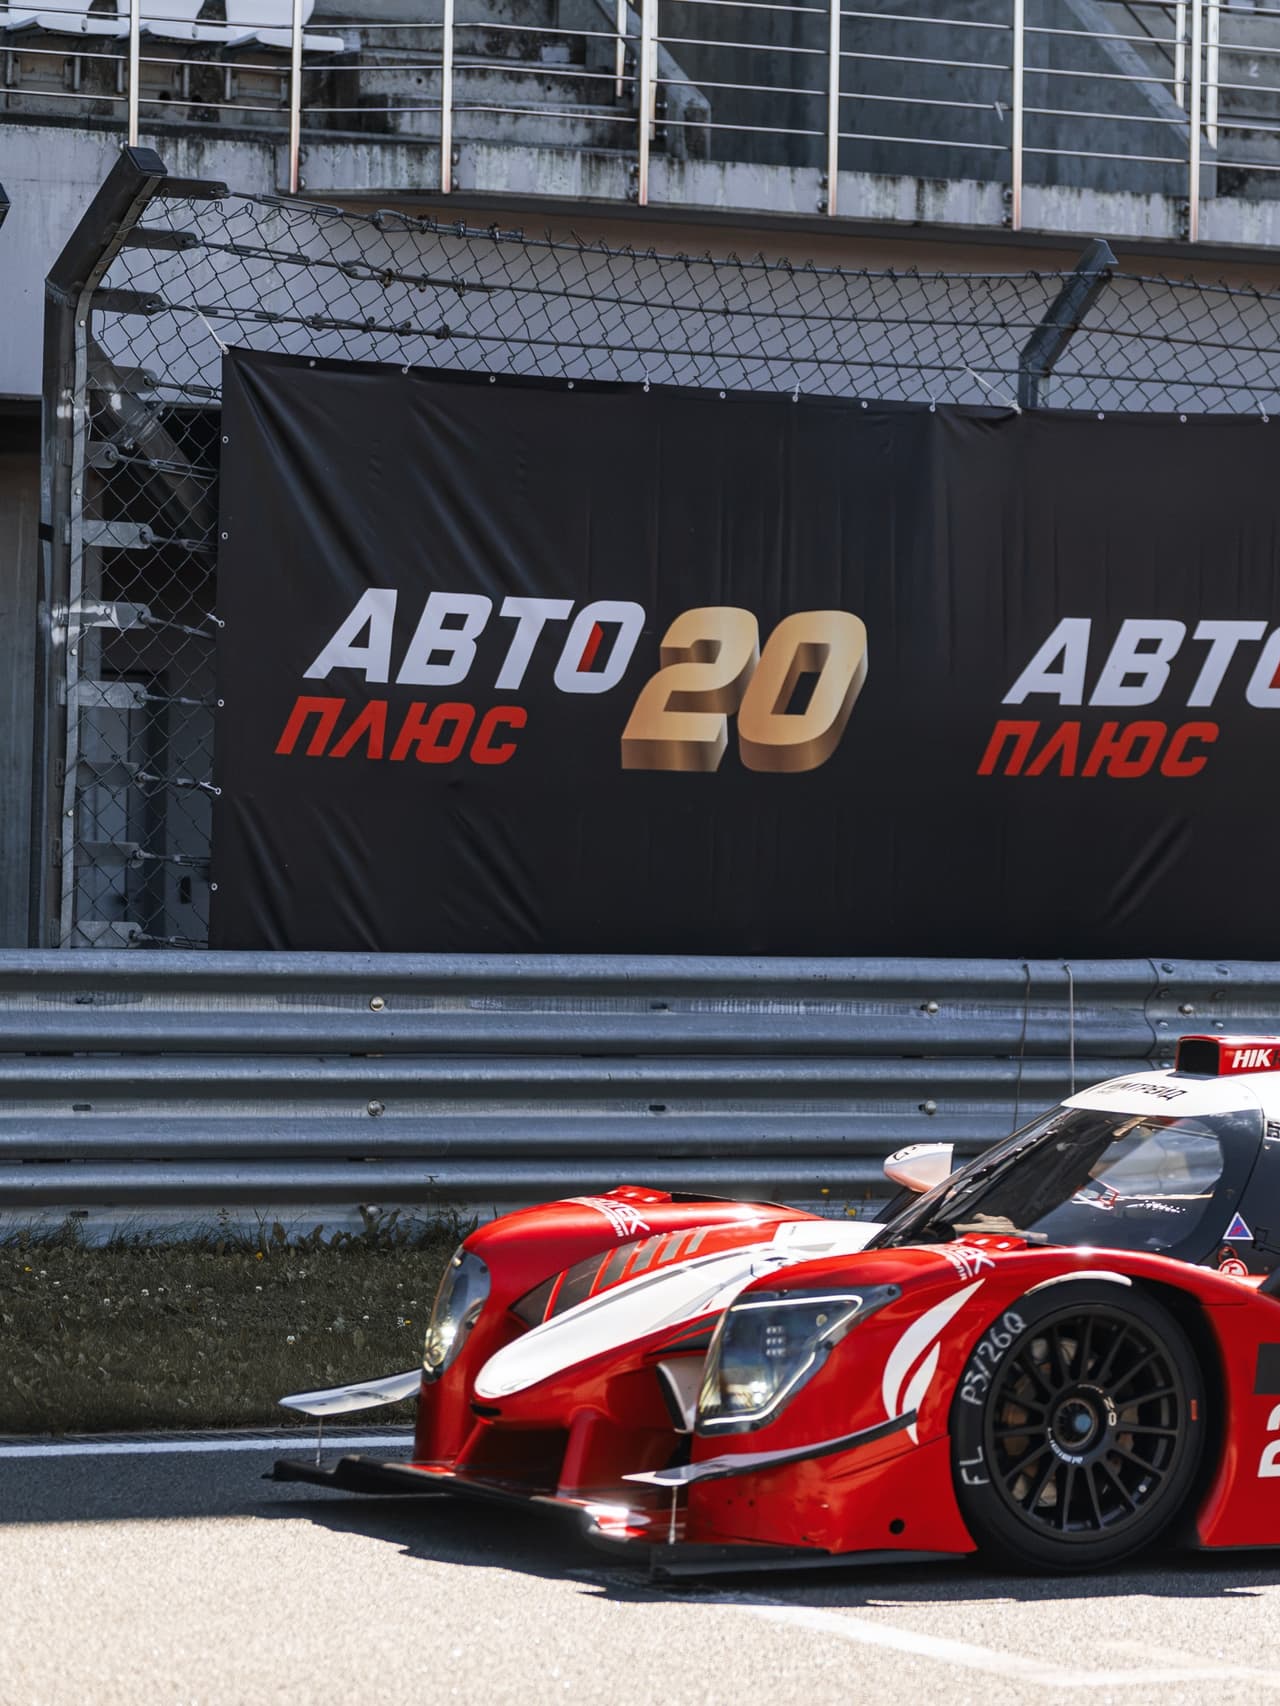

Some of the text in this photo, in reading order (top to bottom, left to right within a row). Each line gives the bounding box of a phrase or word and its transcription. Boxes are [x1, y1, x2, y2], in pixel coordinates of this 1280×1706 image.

[303, 588, 868, 773] АВТО 20
[274, 696, 527, 764] ПЛЮС
[976, 720, 1219, 778] ПЛЮС
[959, 1445, 990, 1486] FL
